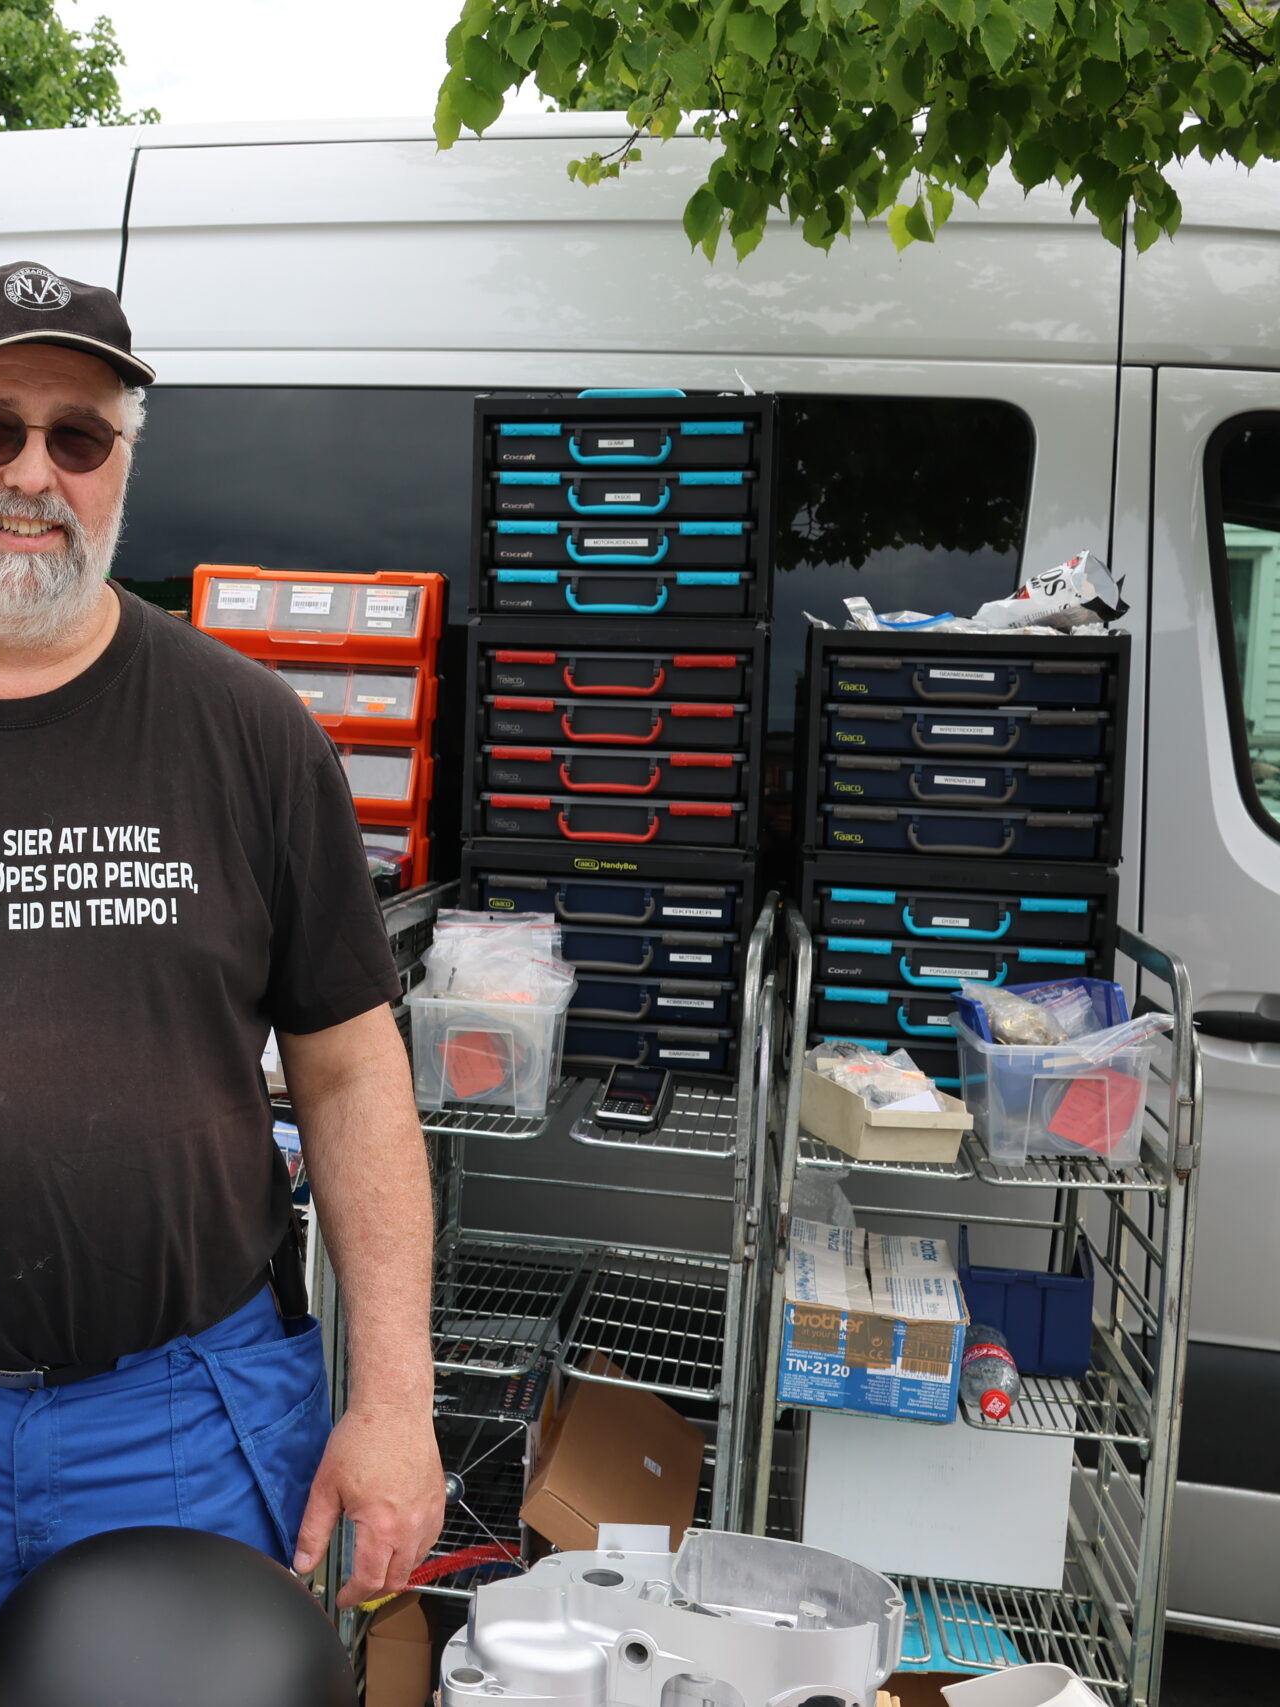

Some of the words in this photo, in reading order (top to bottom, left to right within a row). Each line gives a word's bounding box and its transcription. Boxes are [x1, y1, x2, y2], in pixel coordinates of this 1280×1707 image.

[502, 453, 536, 461] Cocraft
[501, 502, 535, 510] Cocraft
[500, 551, 534, 559] Cocraft
[499, 599, 533, 607] Cocraft
[840, 682, 866, 692] raaco
[837, 733, 863, 743] raaco
[836, 783, 862, 793] raaco
[2, 828, 52, 857] SIER
[58, 827, 87, 854] AT
[93, 825, 160, 853] LYKKE
[836, 832, 862, 842] raaco
[577, 860, 597, 869] raaco
[600, 861, 638, 871] HandyBox
[53, 862, 98, 890] FOR
[104, 861, 199, 894] PENGER,
[8, 901, 45, 930] EID
[50, 900, 81, 929] EN
[831, 917, 866, 926] Cocraft
[827, 967, 862, 976] Cocraft
[790, 1308, 865, 1334] brother
[786, 1358, 850, 1378] TN-2120
